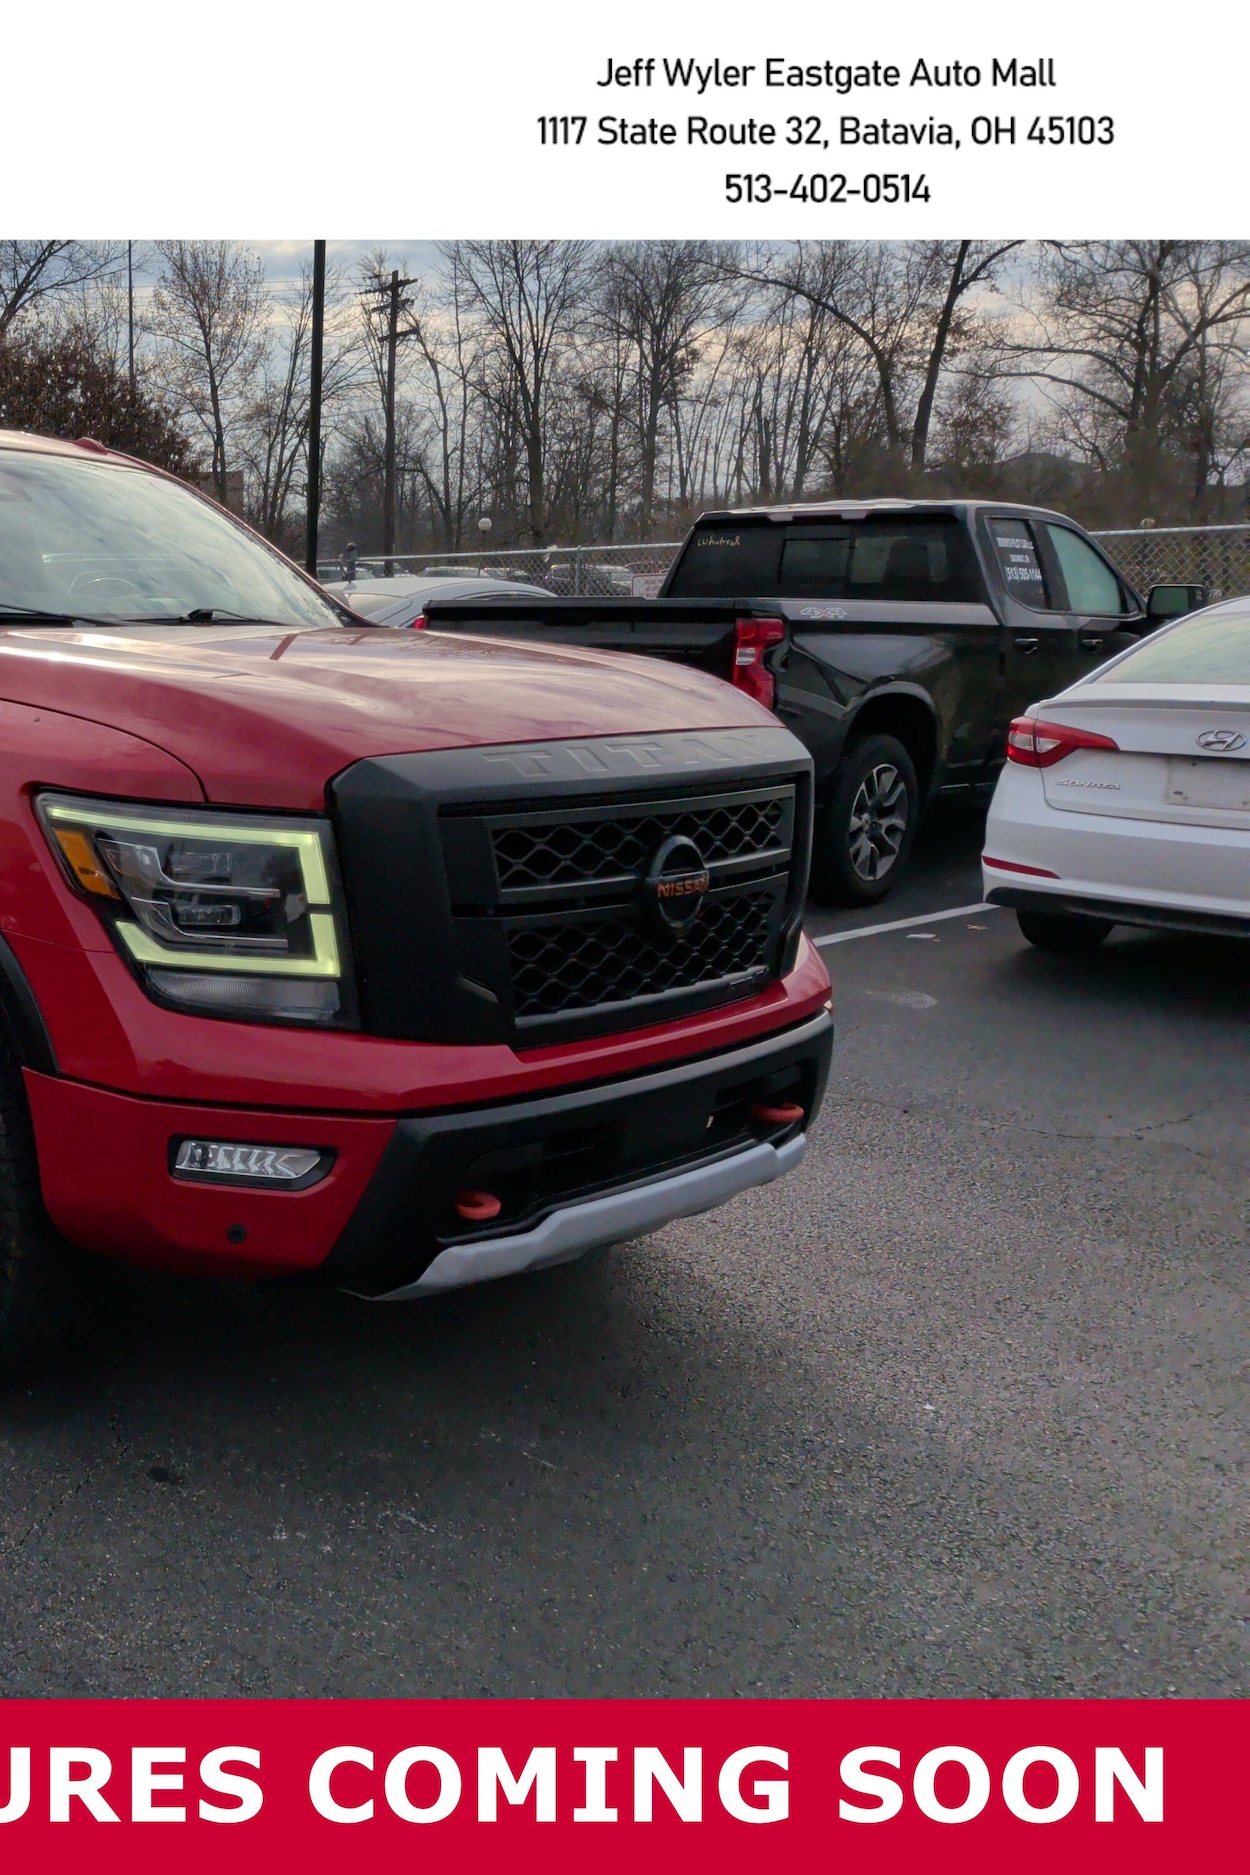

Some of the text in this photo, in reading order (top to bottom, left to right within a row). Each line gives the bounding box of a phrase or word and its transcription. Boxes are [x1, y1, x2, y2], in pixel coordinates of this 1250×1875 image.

[481, 734, 775, 778] TITAN
[1055, 777, 1121, 791] SONATA
[657, 873, 709, 898] NISSAN
